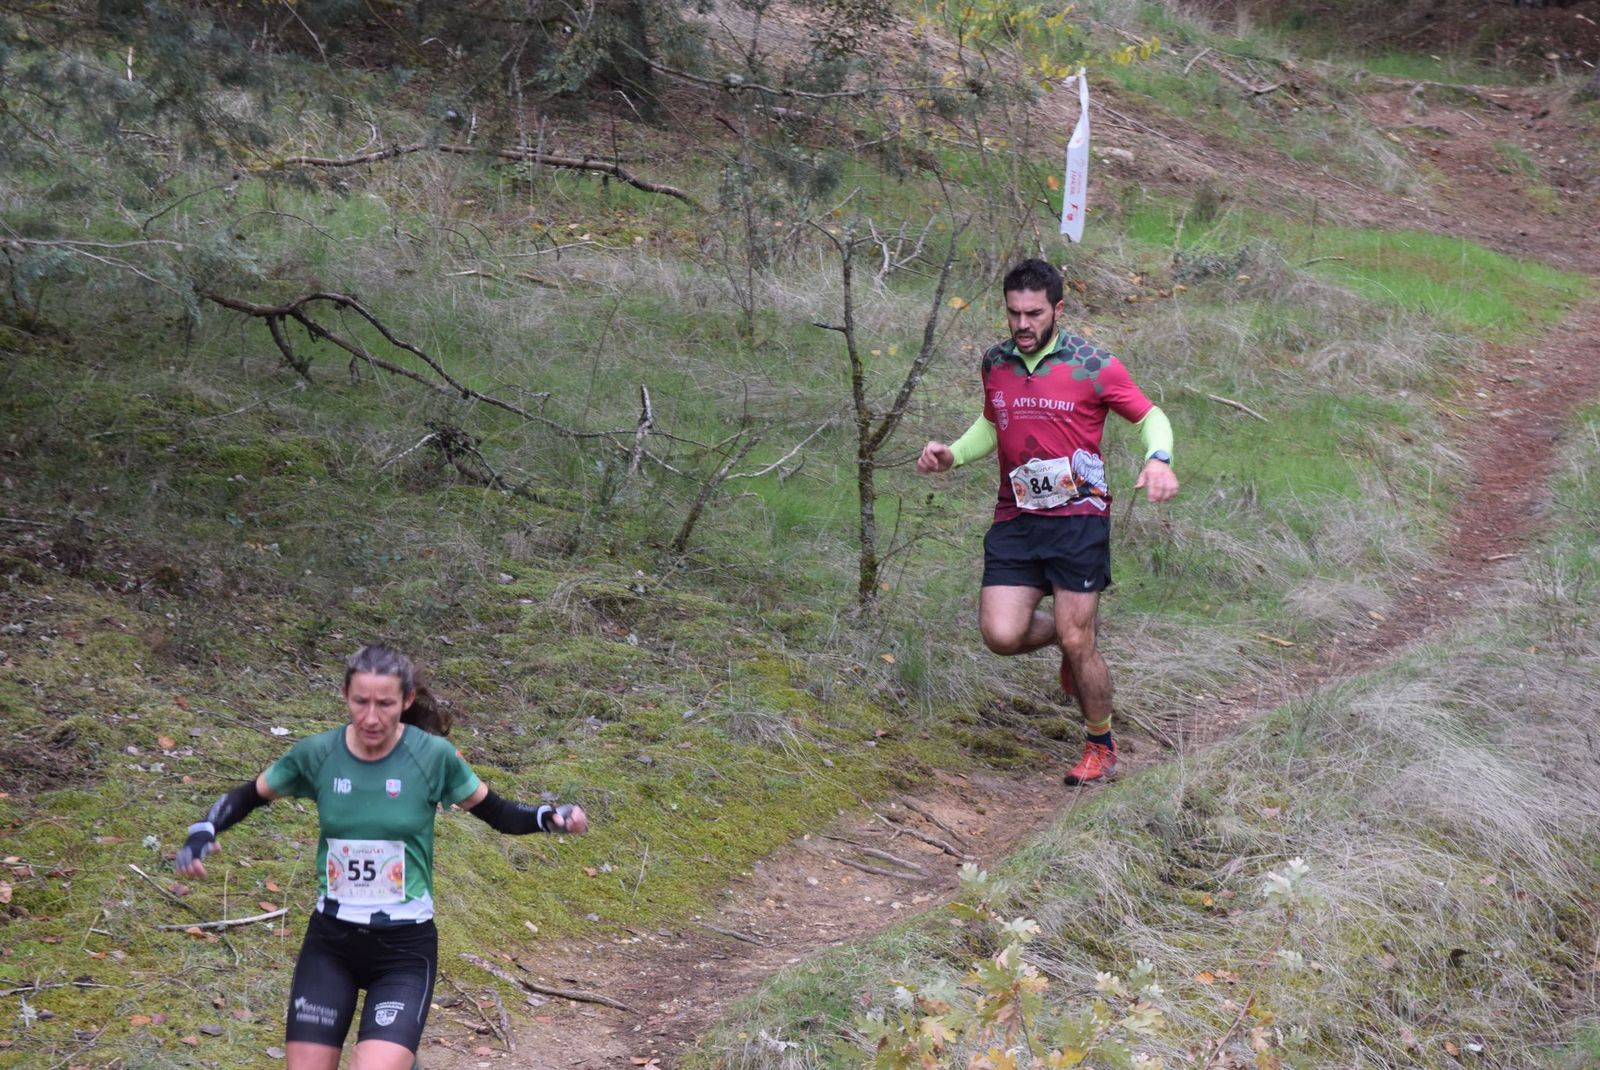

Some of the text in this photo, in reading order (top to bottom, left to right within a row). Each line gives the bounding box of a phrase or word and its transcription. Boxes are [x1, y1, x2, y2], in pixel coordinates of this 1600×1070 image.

[1013, 397, 1075, 412] APIS DURII
[1030, 476, 1053, 495] 84
[348, 860, 376, 881] 55
